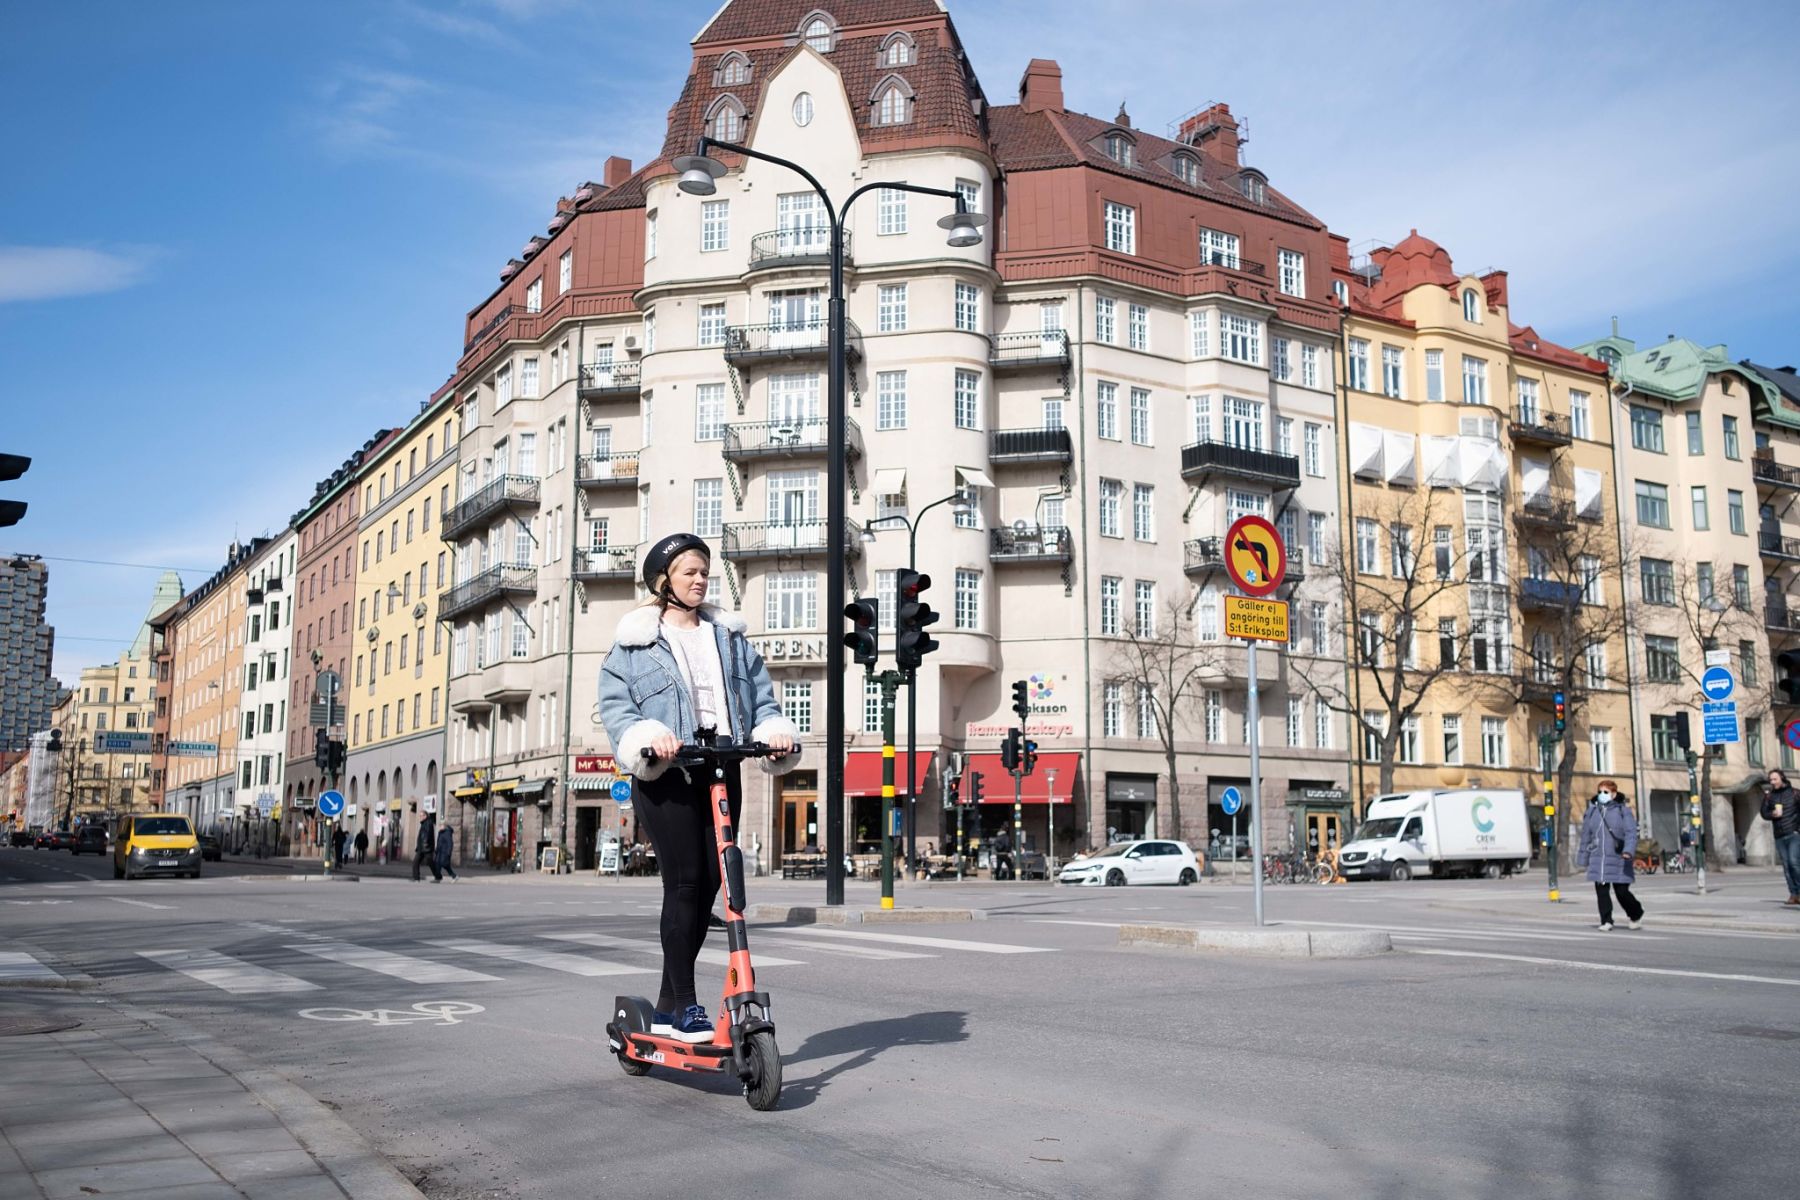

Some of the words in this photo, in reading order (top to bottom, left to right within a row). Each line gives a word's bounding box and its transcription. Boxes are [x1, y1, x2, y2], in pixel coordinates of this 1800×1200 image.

[1238, 600, 1264, 611] Gäller
[1268, 605, 1276, 614] ej
[1230, 612, 1270, 625] angöring
[1273, 616, 1284, 625] till
[1230, 623, 1241, 632] S:t
[1244, 624, 1285, 637] Eriksplan
[754, 639, 824, 660] TEEN
[1026, 703, 1067, 713] aksson
[968, 722, 1009, 736] itama
[578, 760, 593, 770] Mr
[596, 759, 616, 770] BEA
